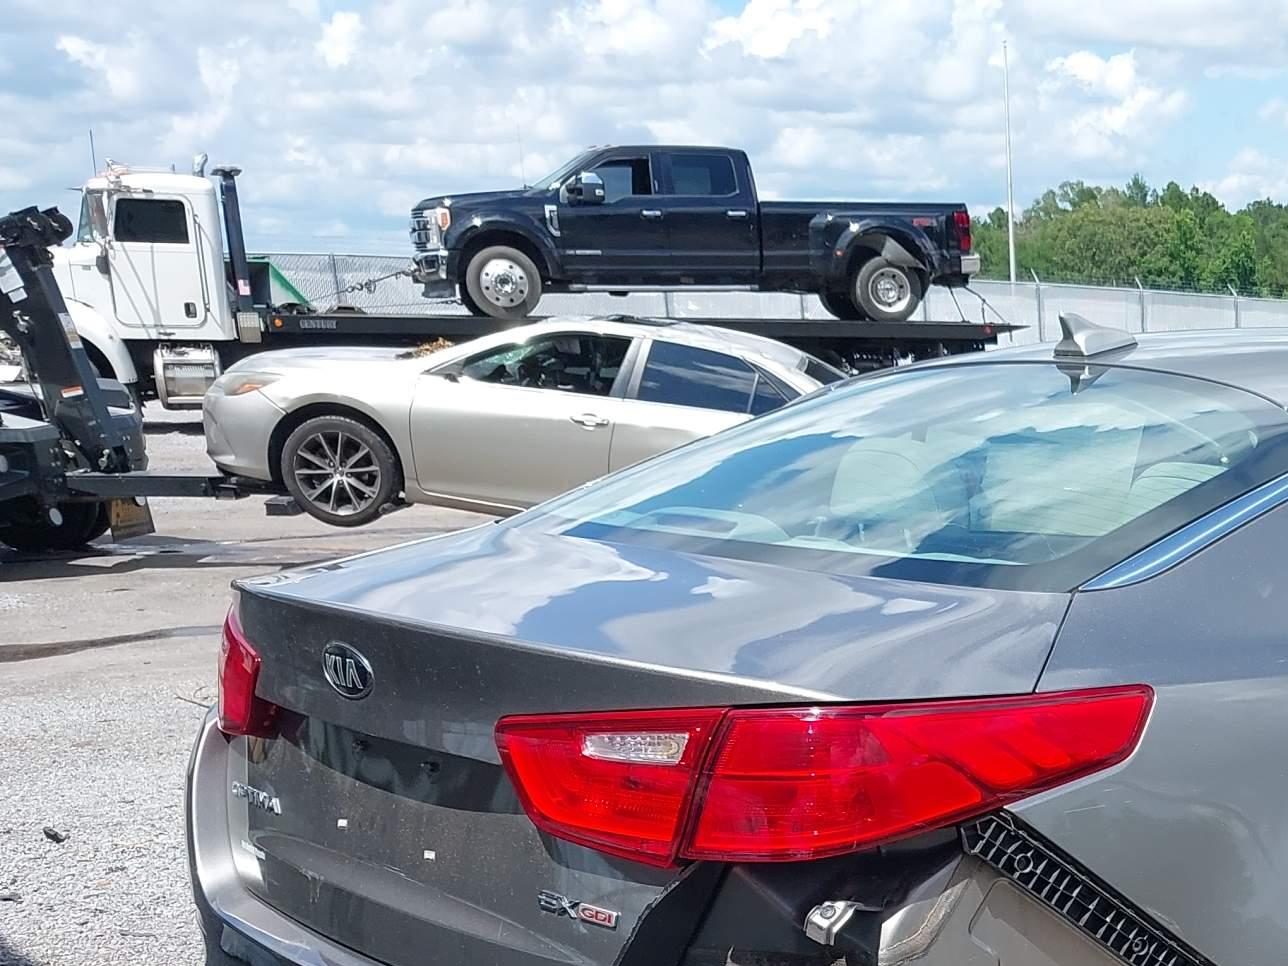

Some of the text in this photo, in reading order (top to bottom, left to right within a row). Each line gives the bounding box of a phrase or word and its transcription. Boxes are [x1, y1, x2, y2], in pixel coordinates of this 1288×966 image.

[299, 319, 337, 329] CENTURY
[324, 653, 364, 689] KIA
[231, 779, 283, 815] OPTIMA
[580, 907, 612, 925] GDI
